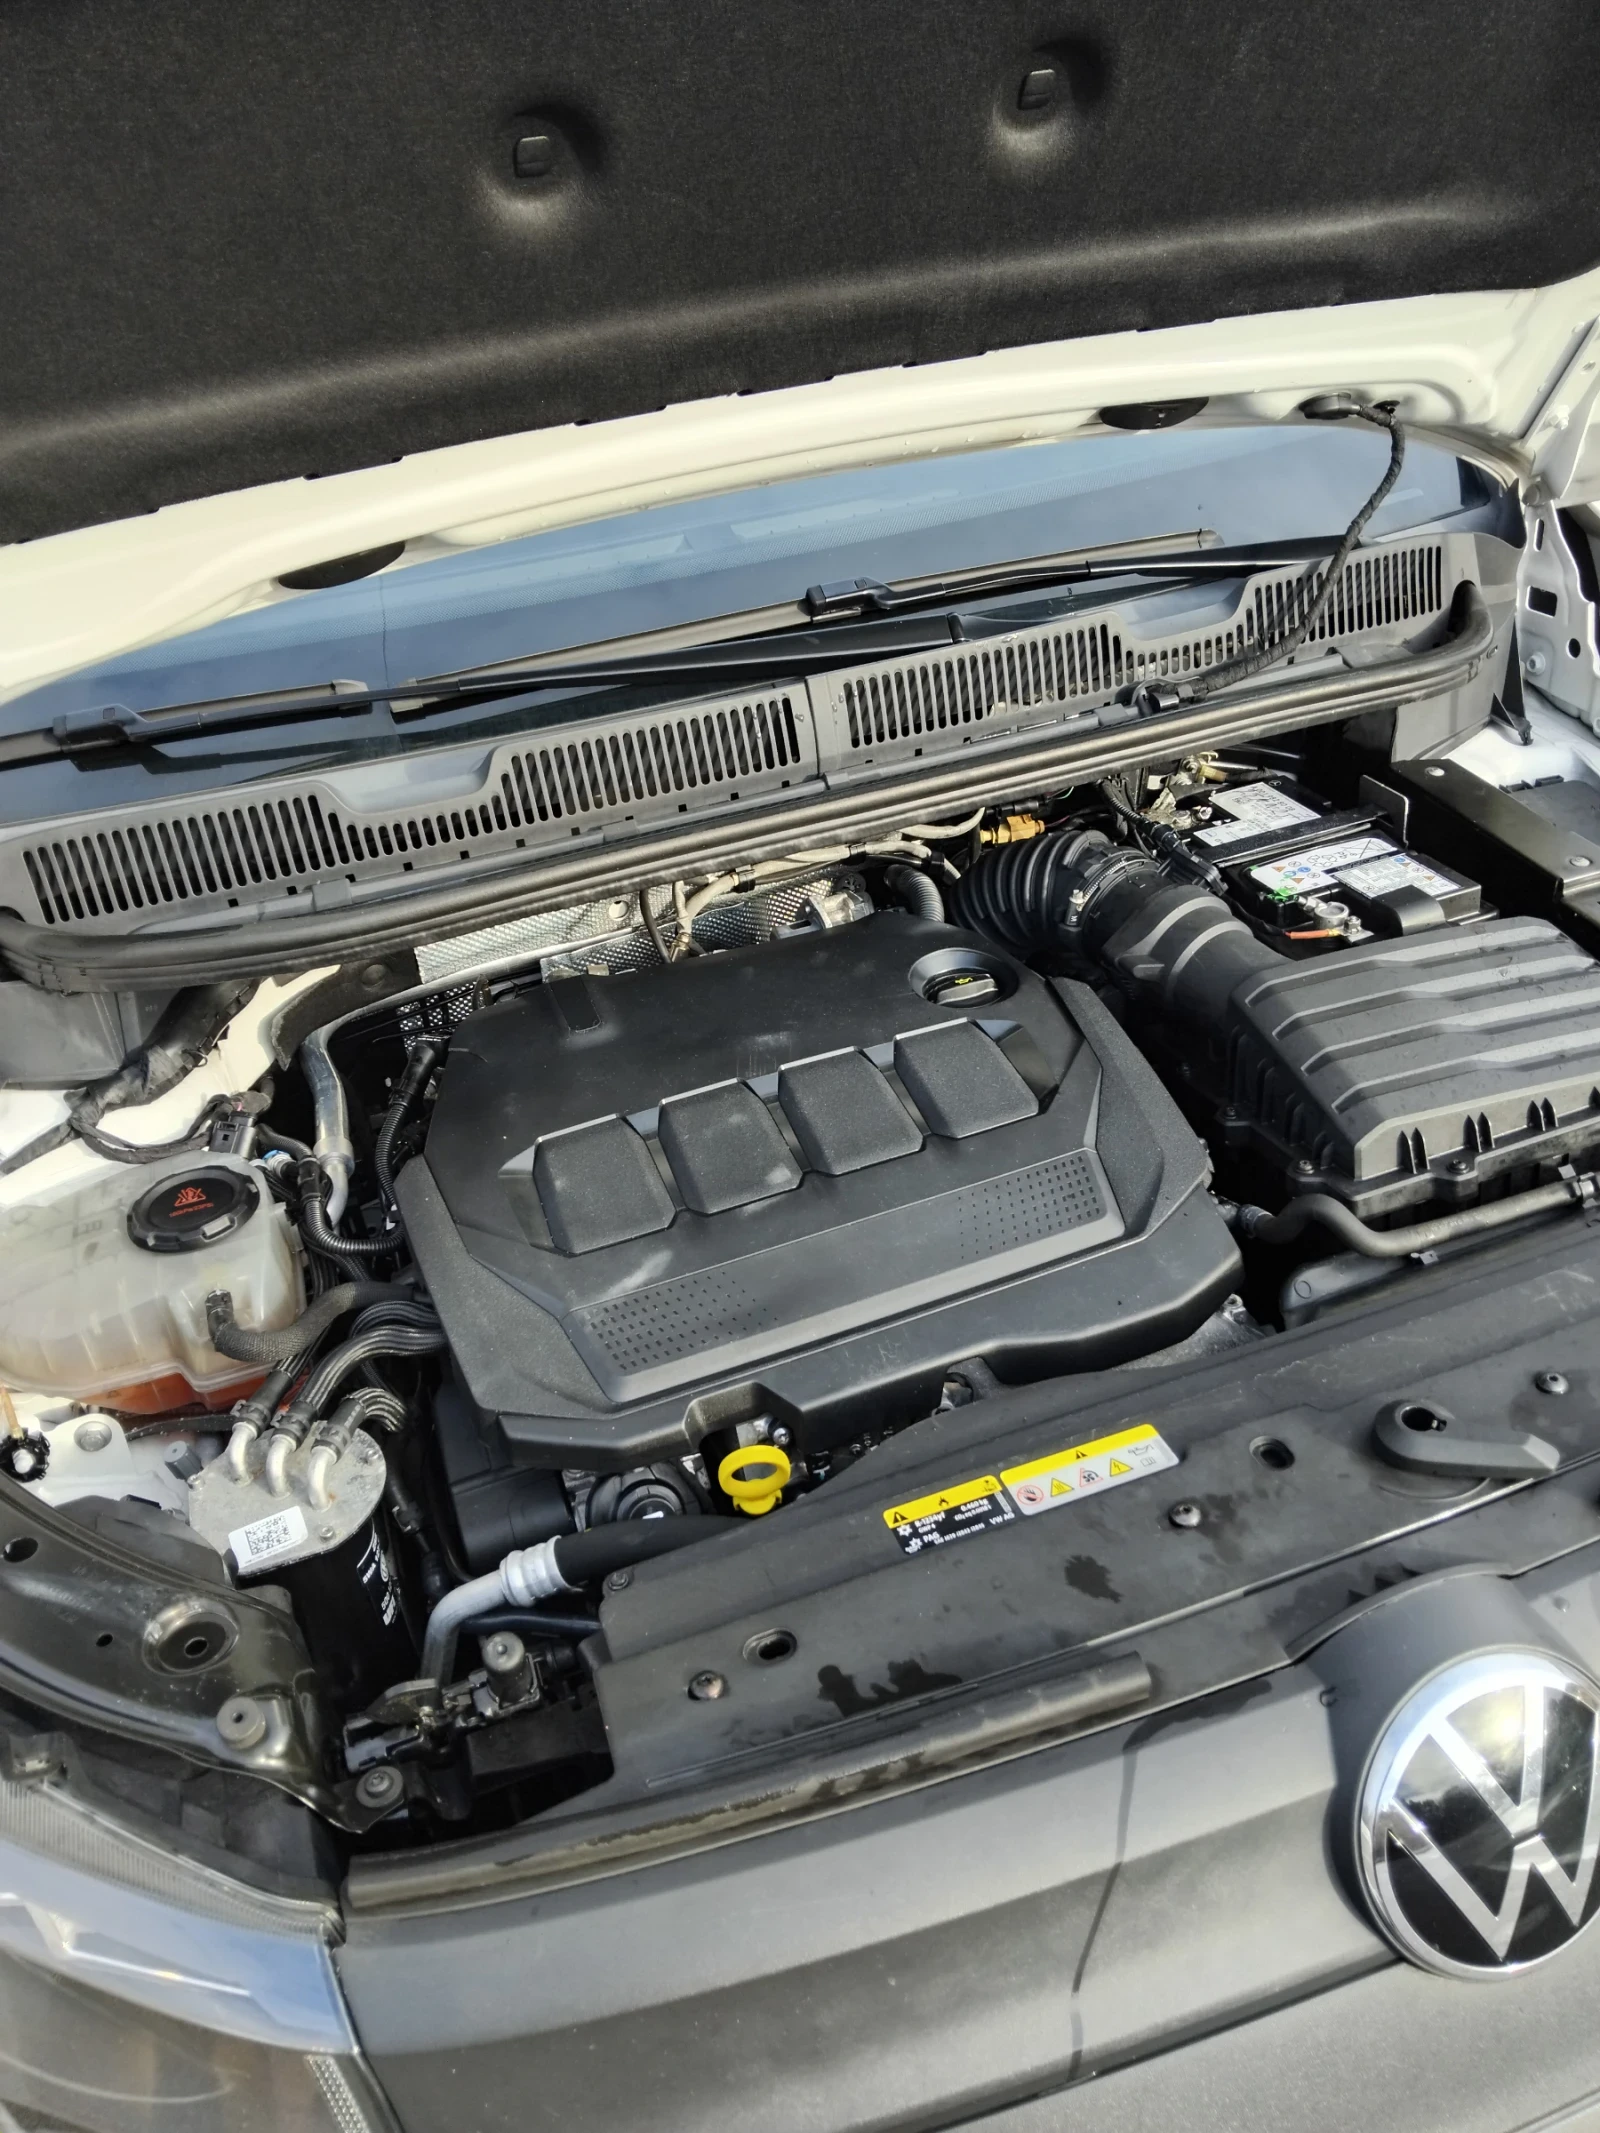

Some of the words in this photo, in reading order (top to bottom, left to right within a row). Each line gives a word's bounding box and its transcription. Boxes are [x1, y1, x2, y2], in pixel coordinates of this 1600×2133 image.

[989, 1515, 1003, 1525] VW
[1003, 1512, 1015, 1521] AG
[923, 1531, 941, 1543] PAG
